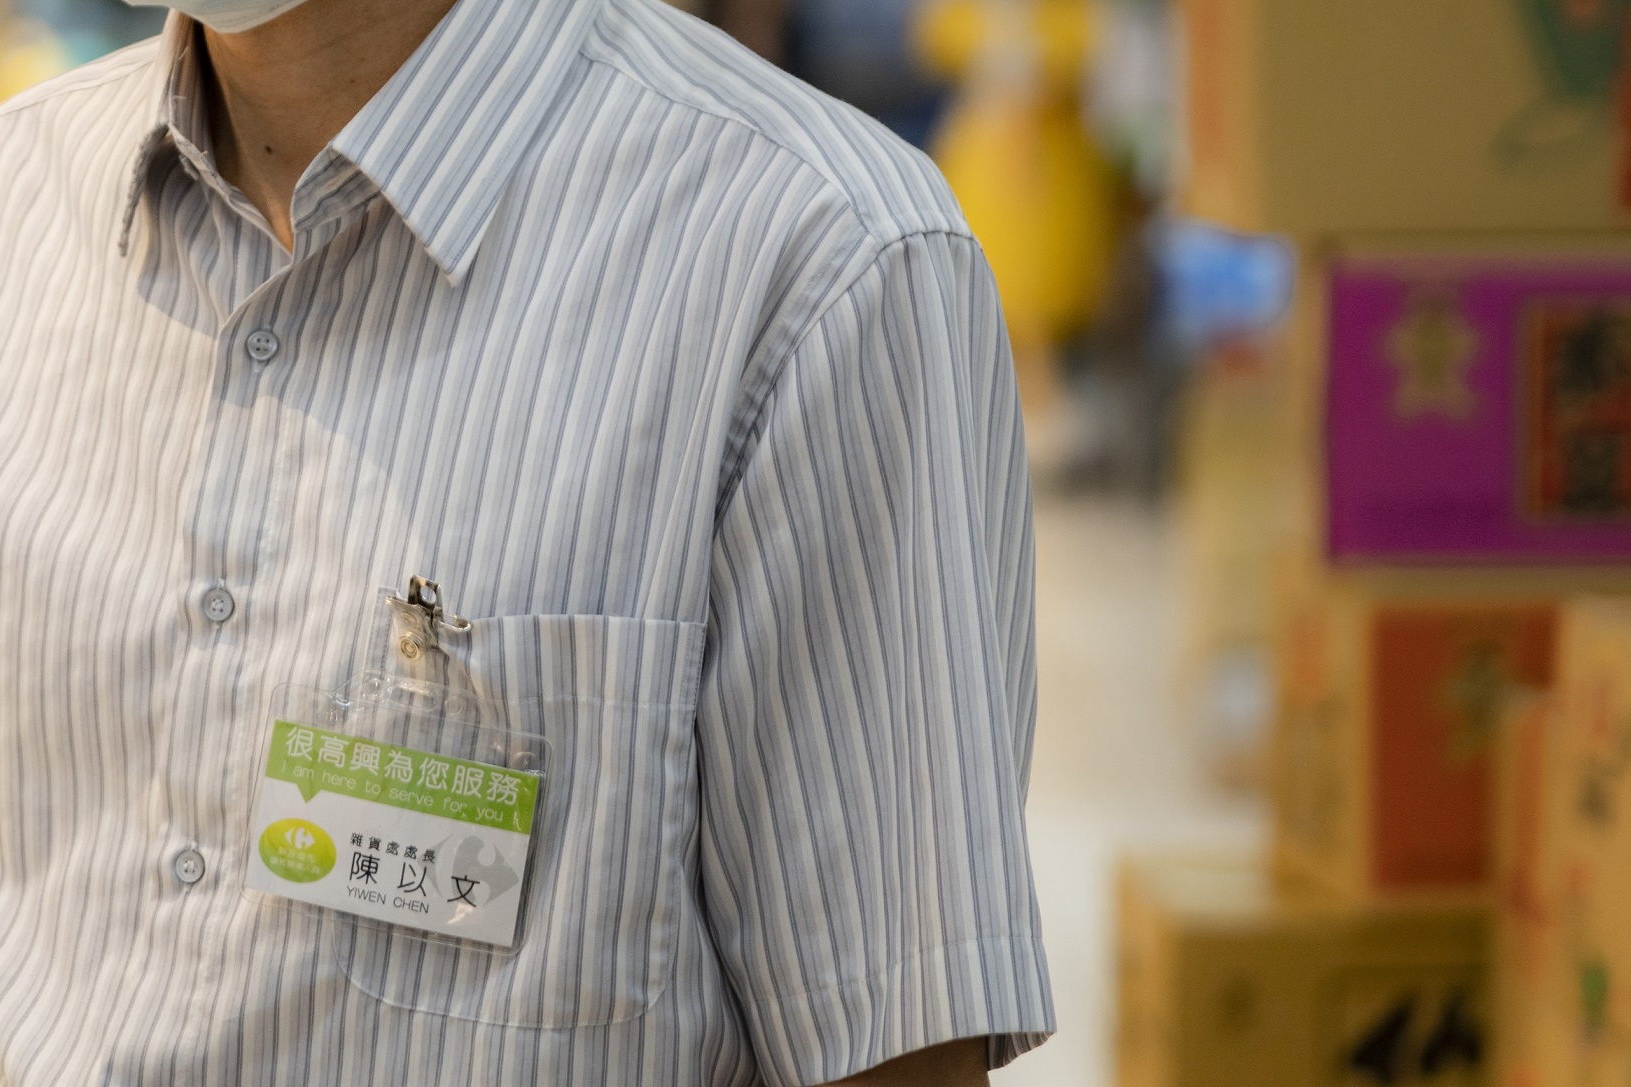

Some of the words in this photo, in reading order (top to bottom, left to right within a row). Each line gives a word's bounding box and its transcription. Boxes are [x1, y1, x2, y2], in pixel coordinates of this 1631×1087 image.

[286, 726, 521, 806] 很高興為您服務
[293, 765, 315, 780] am
[321, 769, 357, 790] here
[365, 779, 382, 795] to
[388, 787, 434, 807] serve
[443, 796, 468, 813] for
[475, 805, 504, 822] you
[346, 885, 387, 905] YIWEN
[393, 896, 430, 914] CHEN
[349, 851, 480, 908] 陳以文
